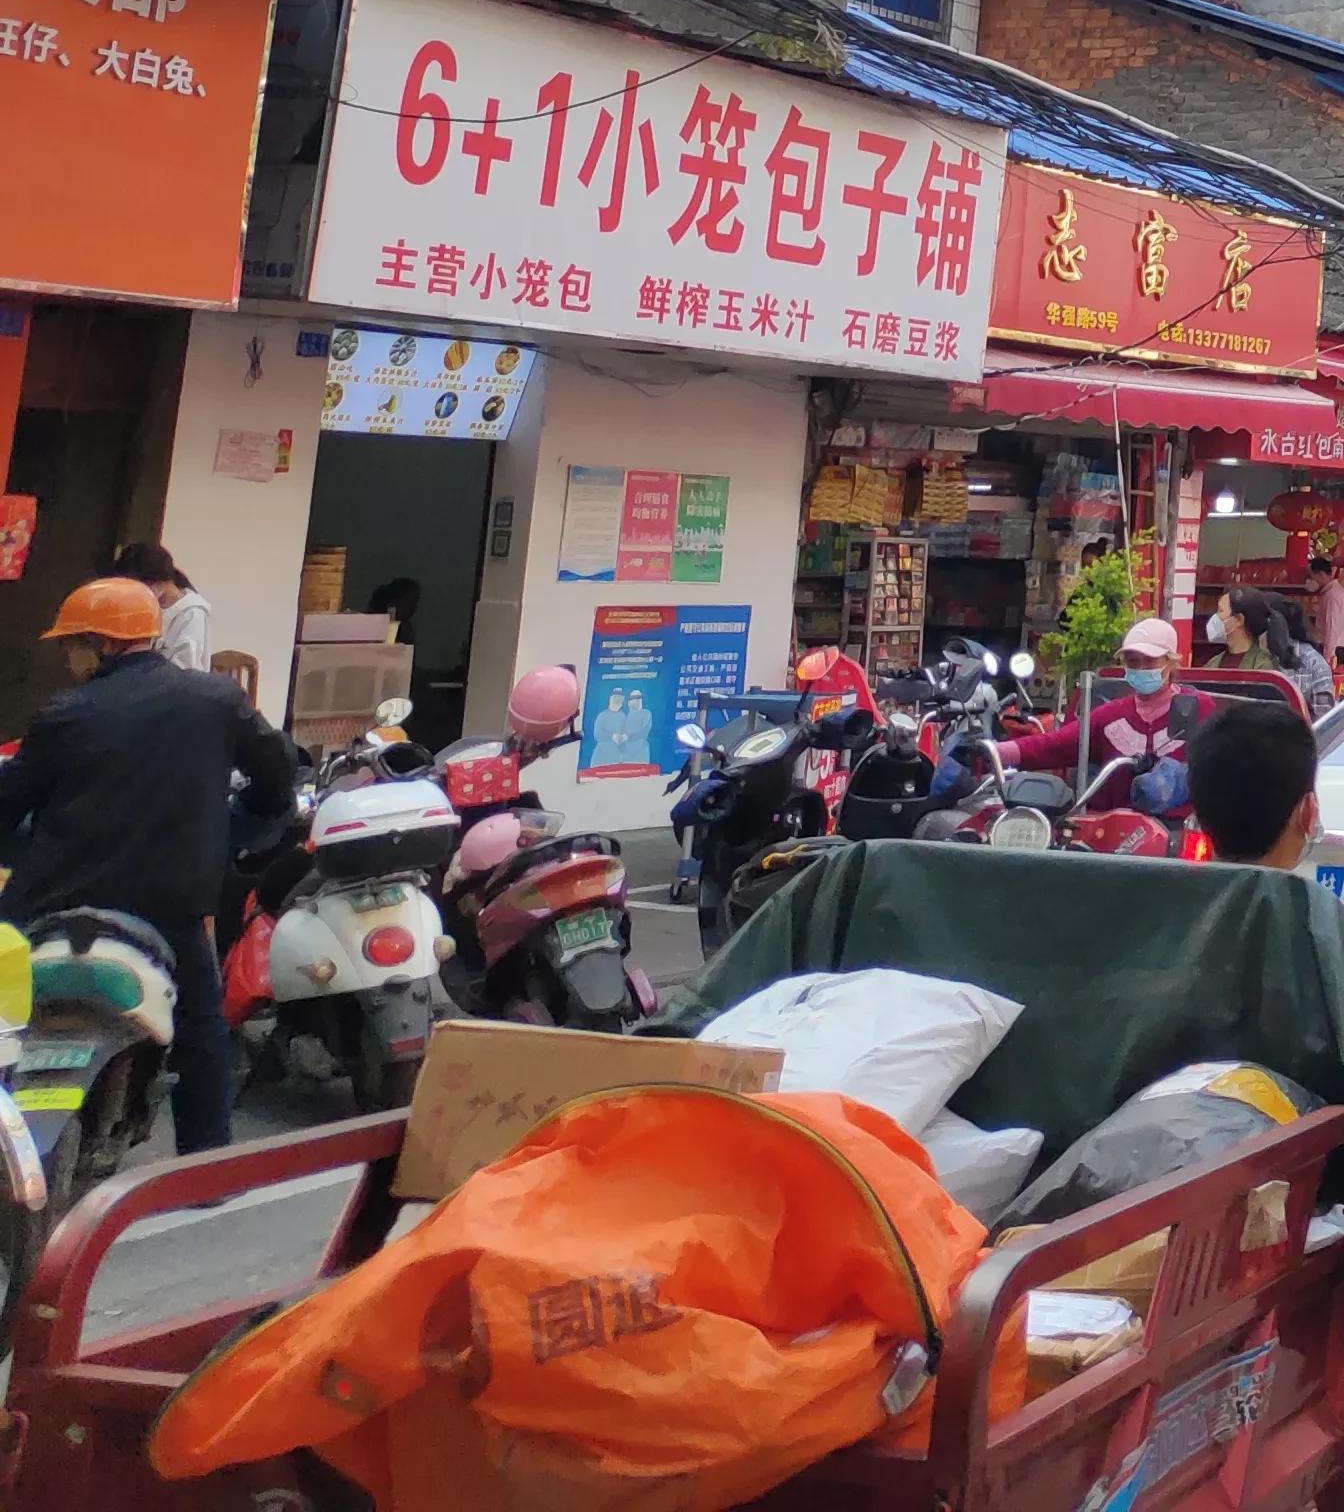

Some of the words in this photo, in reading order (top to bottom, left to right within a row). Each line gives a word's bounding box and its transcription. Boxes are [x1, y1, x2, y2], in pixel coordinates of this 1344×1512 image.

[396, 40, 984, 296] 6+1小笼包子铺
[375, 240, 593, 313] 主营小笼包
[635, 275, 816, 343] 鲜榨玉米汁
[842, 307, 960, 361] 石磨豆浆
